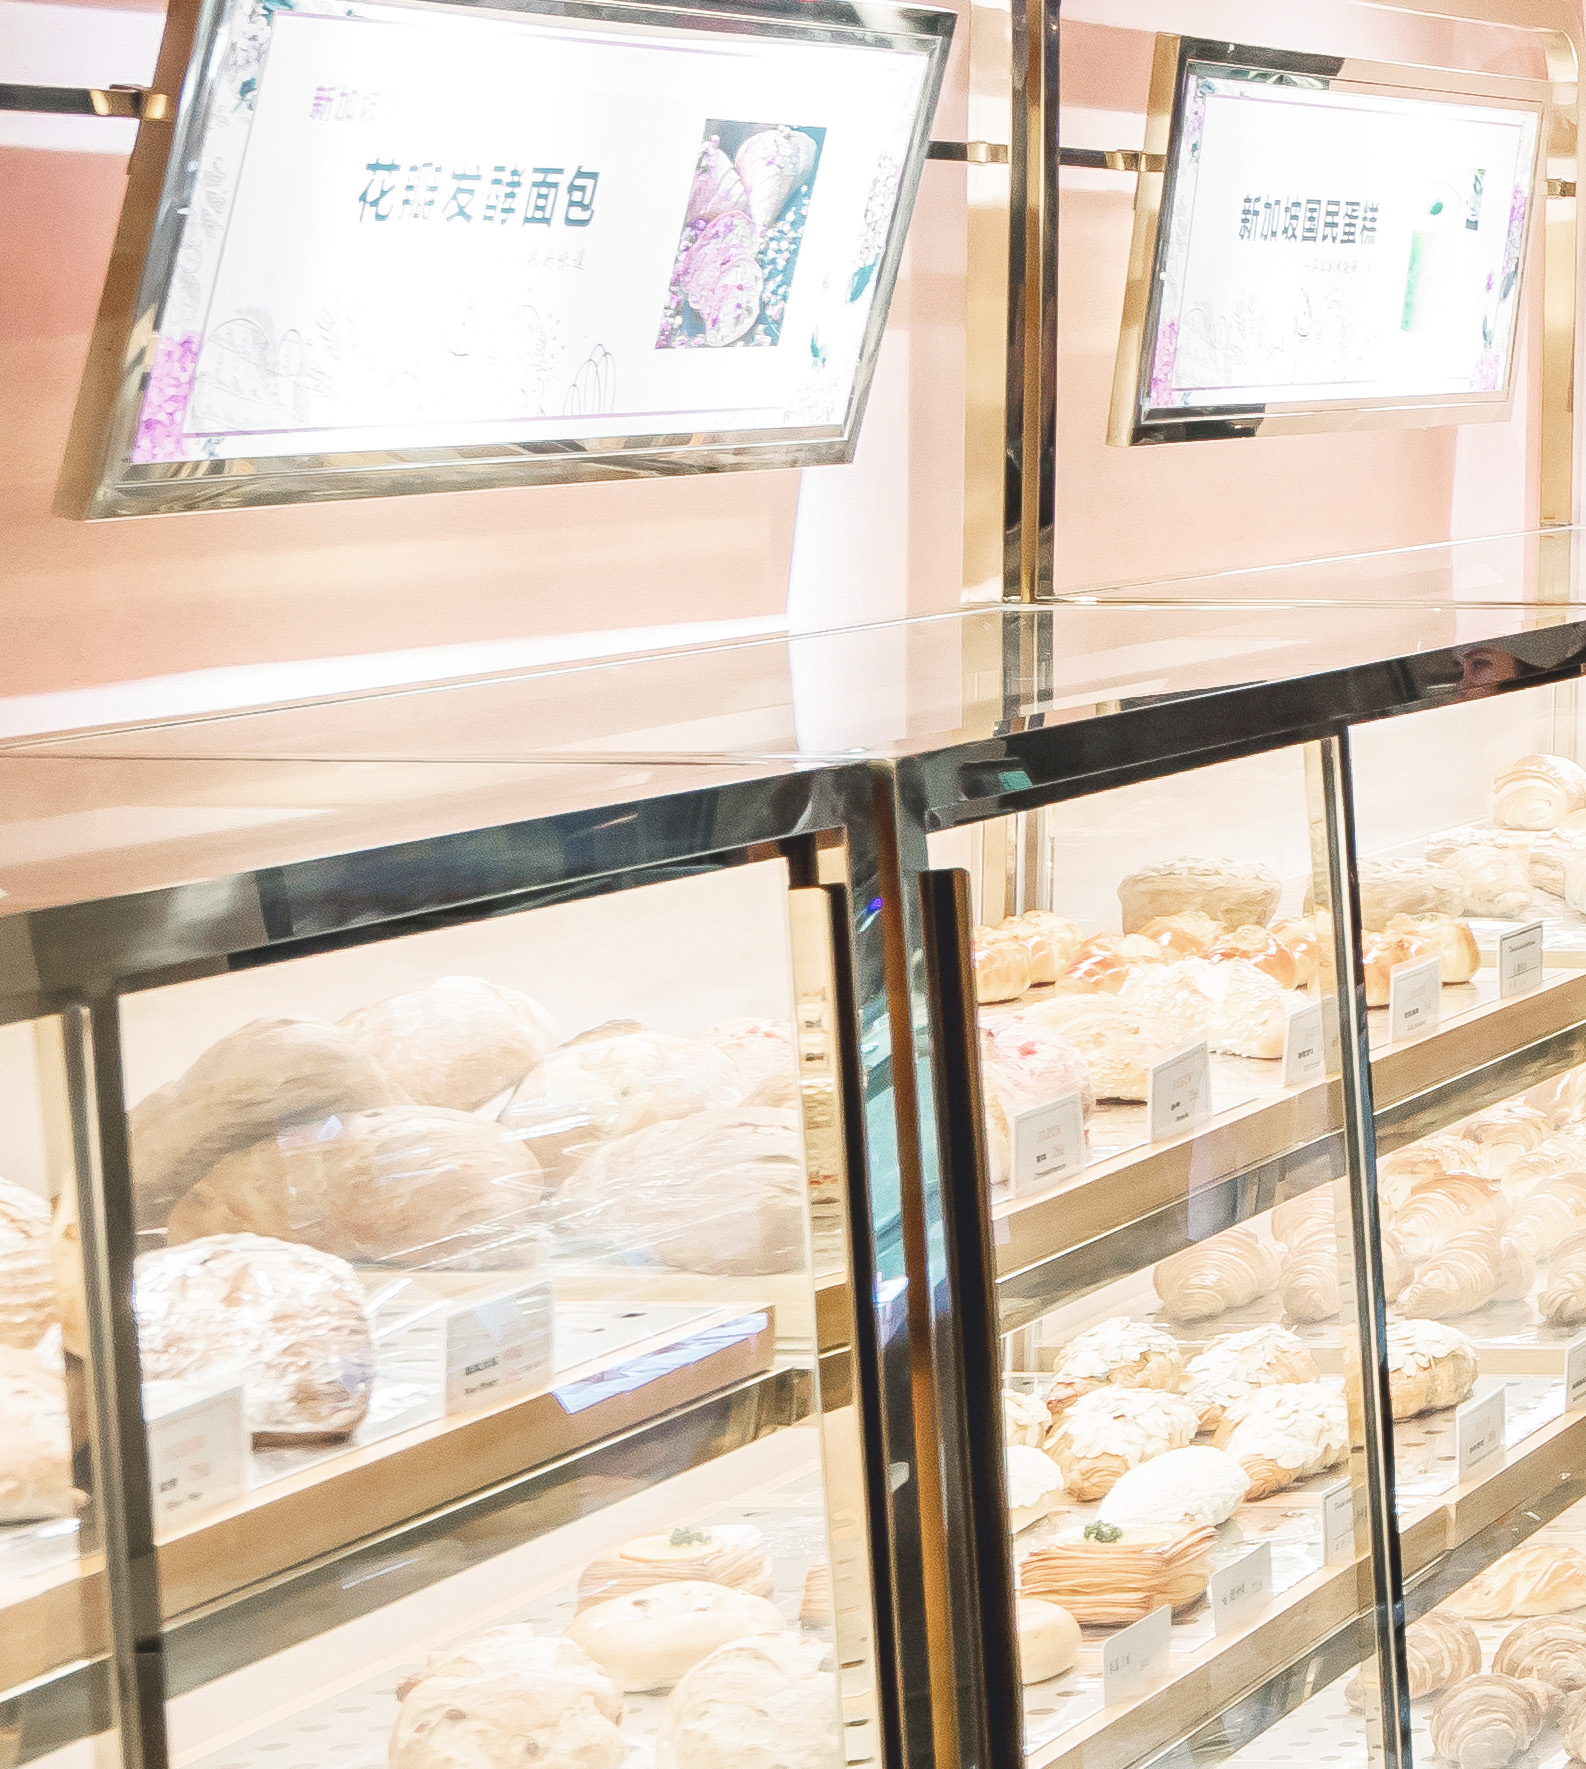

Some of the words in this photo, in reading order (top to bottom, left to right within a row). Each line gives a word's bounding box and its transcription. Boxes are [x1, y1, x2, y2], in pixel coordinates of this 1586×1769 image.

[358, 157, 601, 228] 花瓣发酵面包
